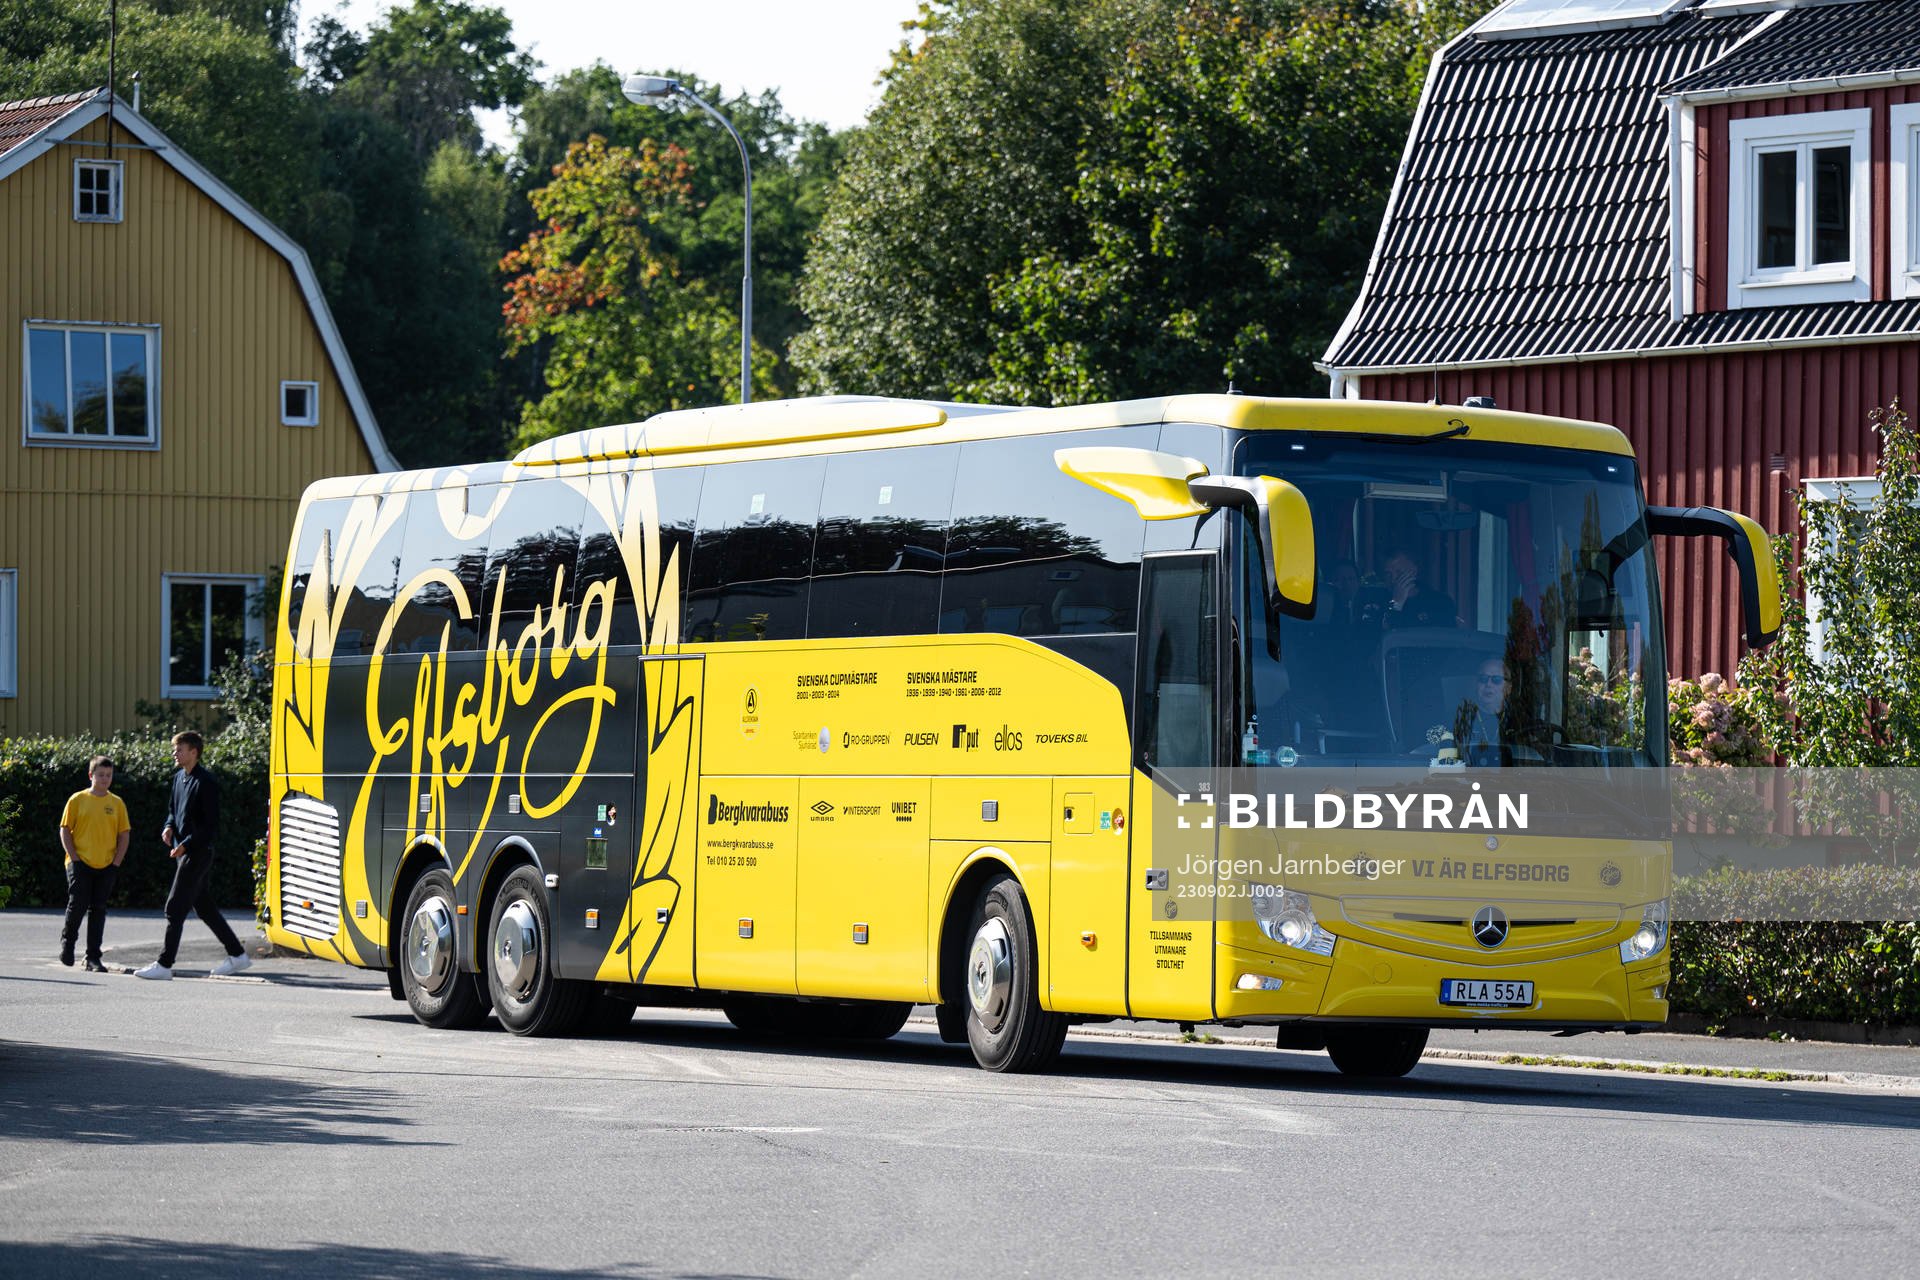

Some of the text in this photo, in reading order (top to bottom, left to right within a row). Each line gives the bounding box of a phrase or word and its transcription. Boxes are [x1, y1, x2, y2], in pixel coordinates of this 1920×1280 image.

[797, 670, 878, 687] SVENSKA CUPMÄSTARE
[907, 668, 978, 684] SVENSKA MÄSTARE
[906, 688, 919, 697] 1936
[922, 688, 935, 697] 1939
[938, 688, 951, 697] 1940
[970, 687, 985, 696] 2006
[988, 687, 1002, 696] 2012
[904, 733, 939, 746] PULSEN
[994, 724, 1023, 751] ellos
[1035, 733, 1089, 744] TOVEKS BIL
[717, 801, 789, 826] Bergkvarabuss
[847, 806, 881, 816] INTERSPORT
[891, 802, 917, 814] UNIBET
[706, 839, 774, 851] www.bergkvarabuss.se
[706, 855, 757, 867] Tel 010 25 20 500
[1412, 857, 1570, 883] VI ÄR ELFSBORG
[1150, 930, 1193, 941] TILLSAMMANS
[1154, 945, 1187, 956] UTMANARE
[1156, 959, 1185, 970] STOLTHET
[1456, 982, 1526, 1001] RLA 55A
